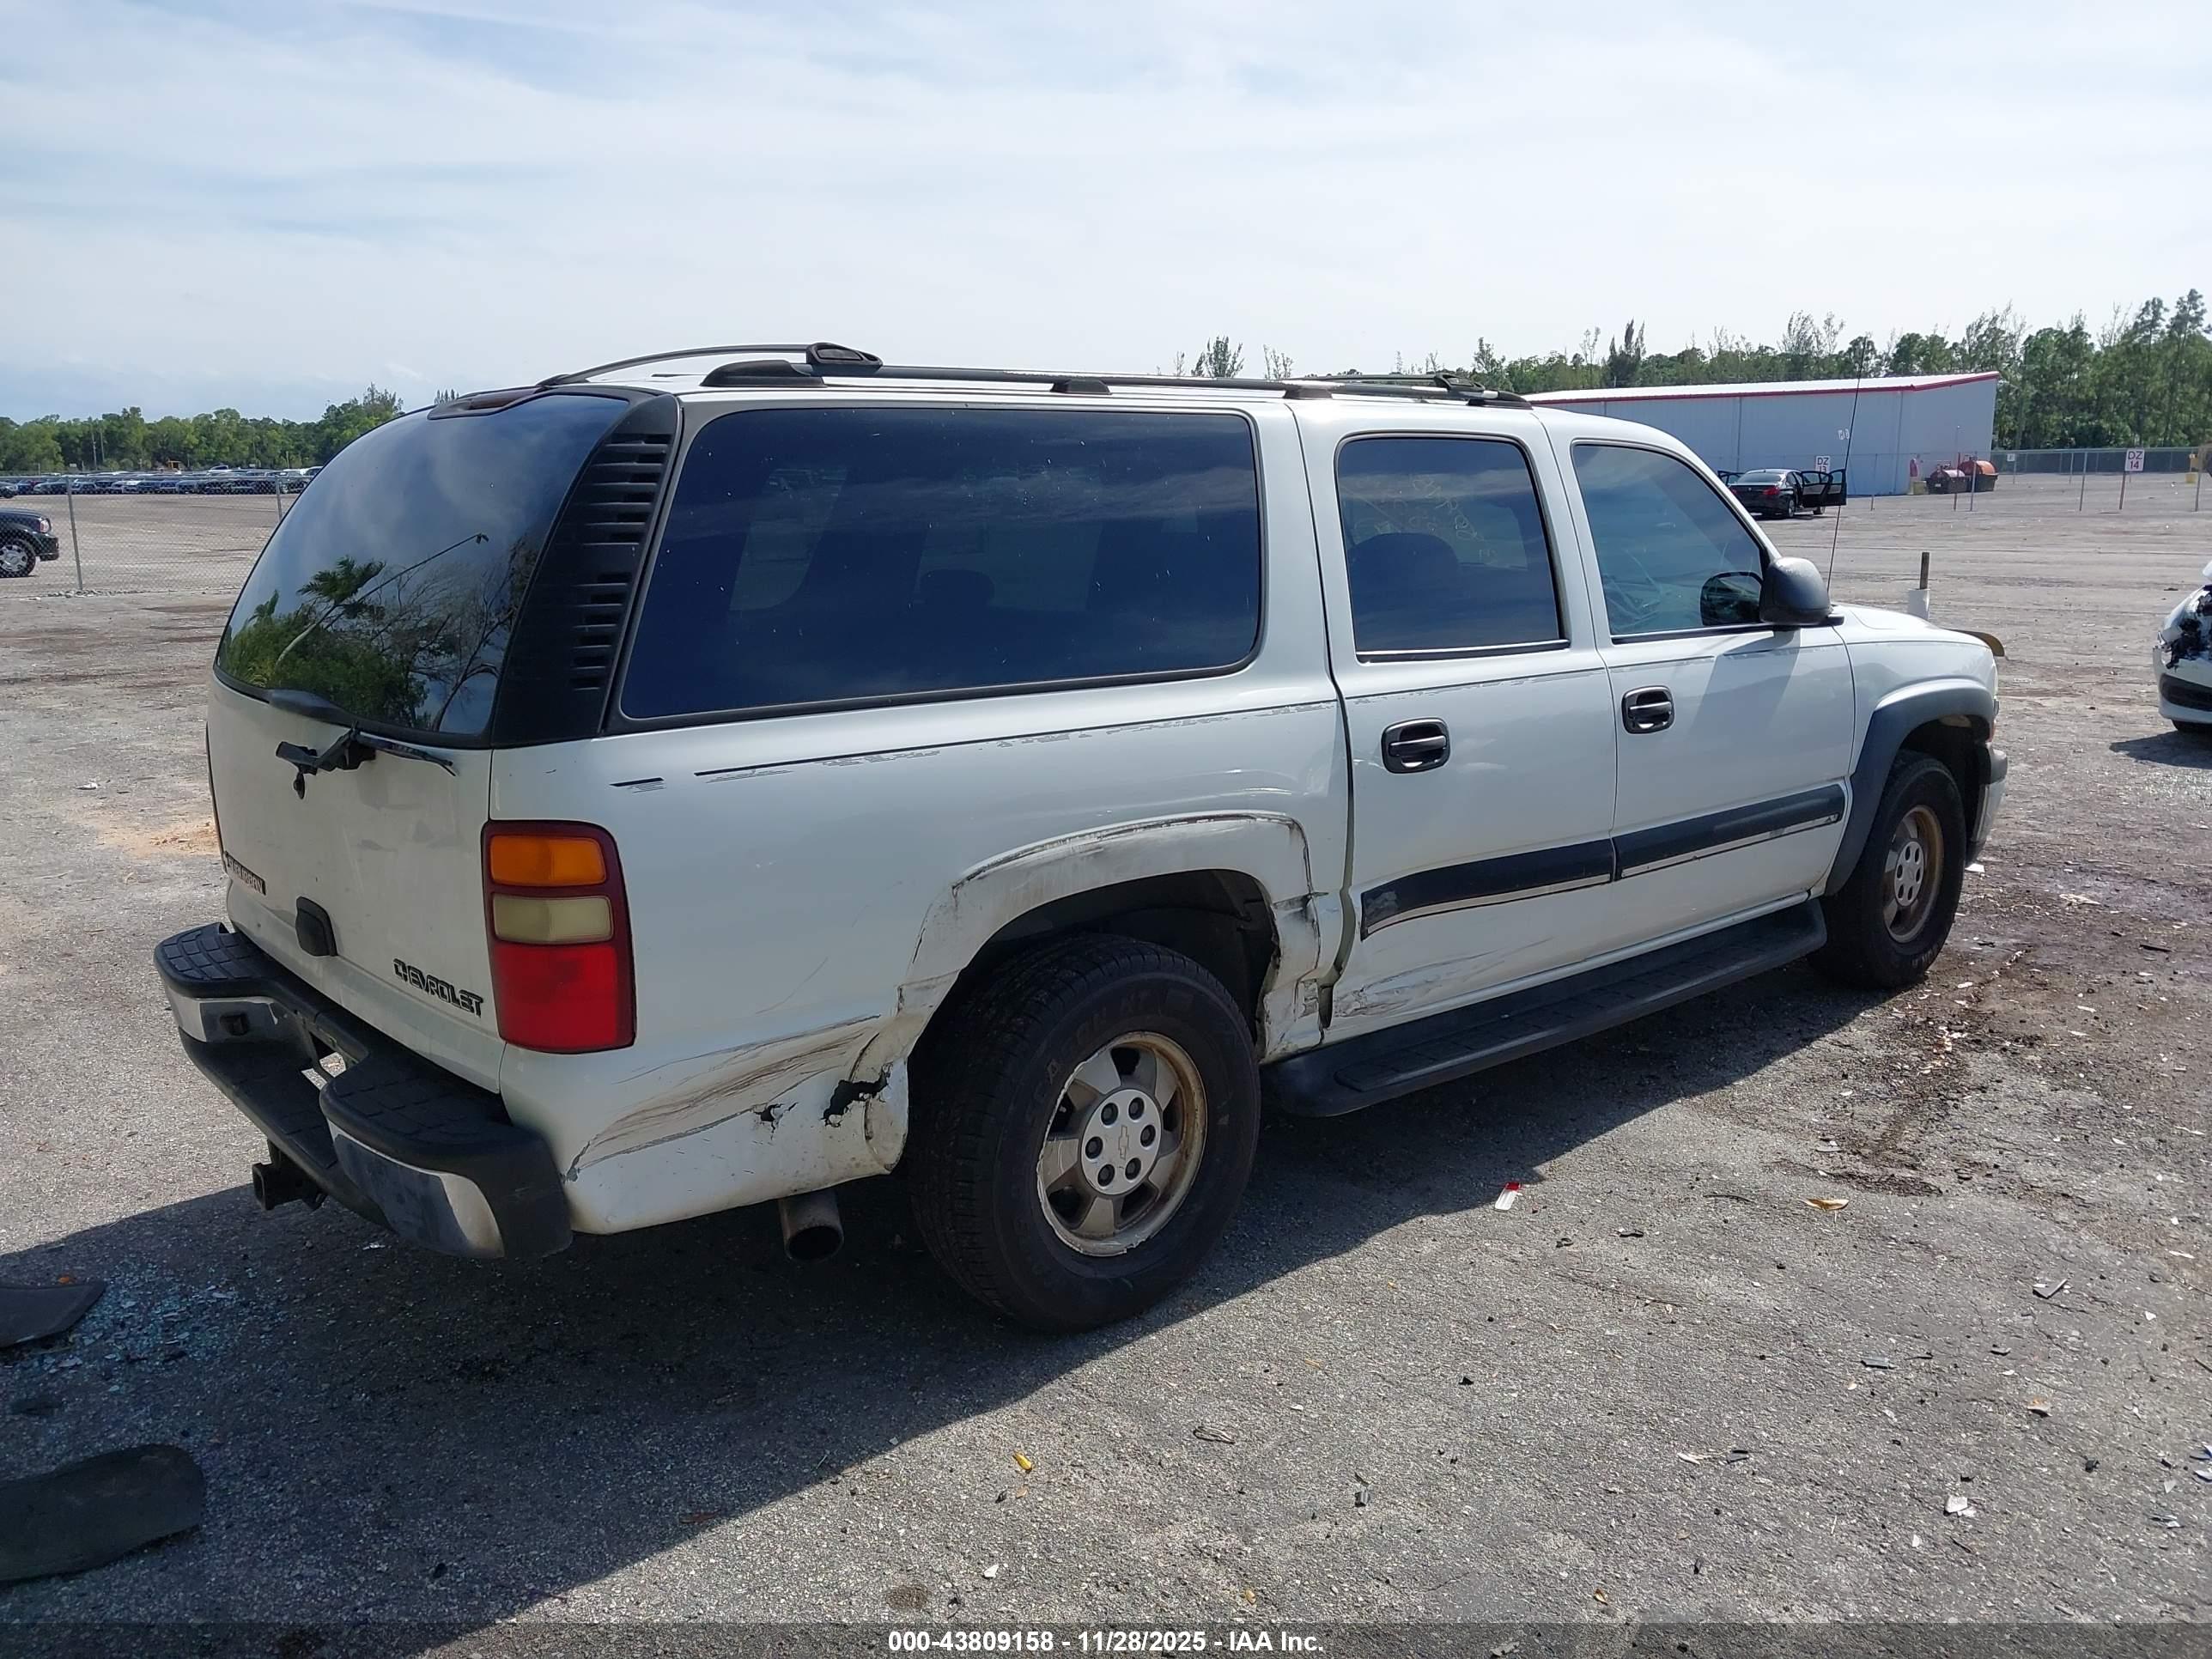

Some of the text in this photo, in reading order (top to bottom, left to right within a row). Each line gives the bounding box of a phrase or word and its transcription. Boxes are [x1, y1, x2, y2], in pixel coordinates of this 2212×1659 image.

[2128, 451, 2143, 459] DZ
[1817, 457, 1829, 465] DZ
[2130, 460, 2139, 470] 14
[393, 958, 483, 1018] CHEVROLET
